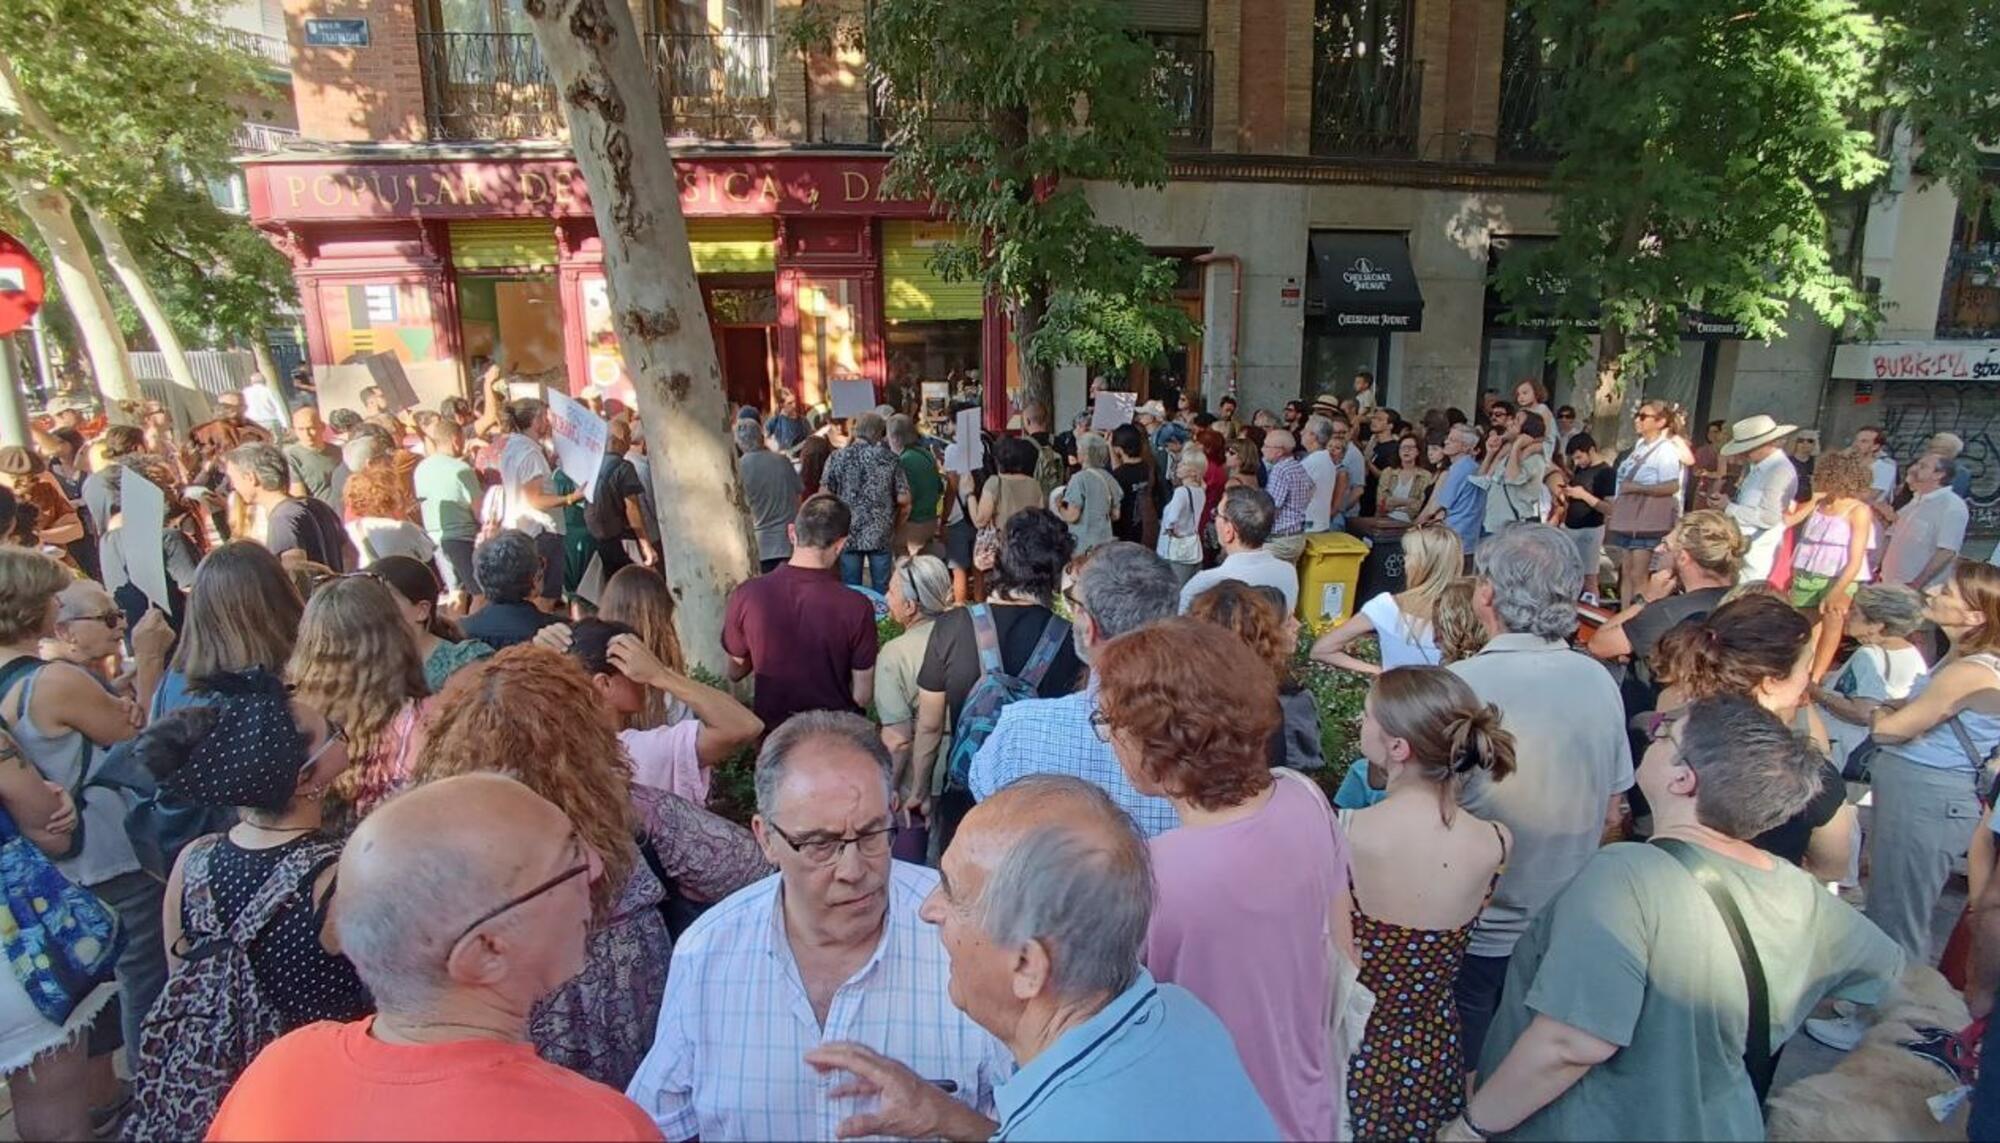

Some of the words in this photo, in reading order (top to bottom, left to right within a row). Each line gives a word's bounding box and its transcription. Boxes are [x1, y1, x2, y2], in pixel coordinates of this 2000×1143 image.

[287, 172, 487, 207] POPULAR
[519, 171, 573, 204] DE
[682, 171, 780, 204] SICA
